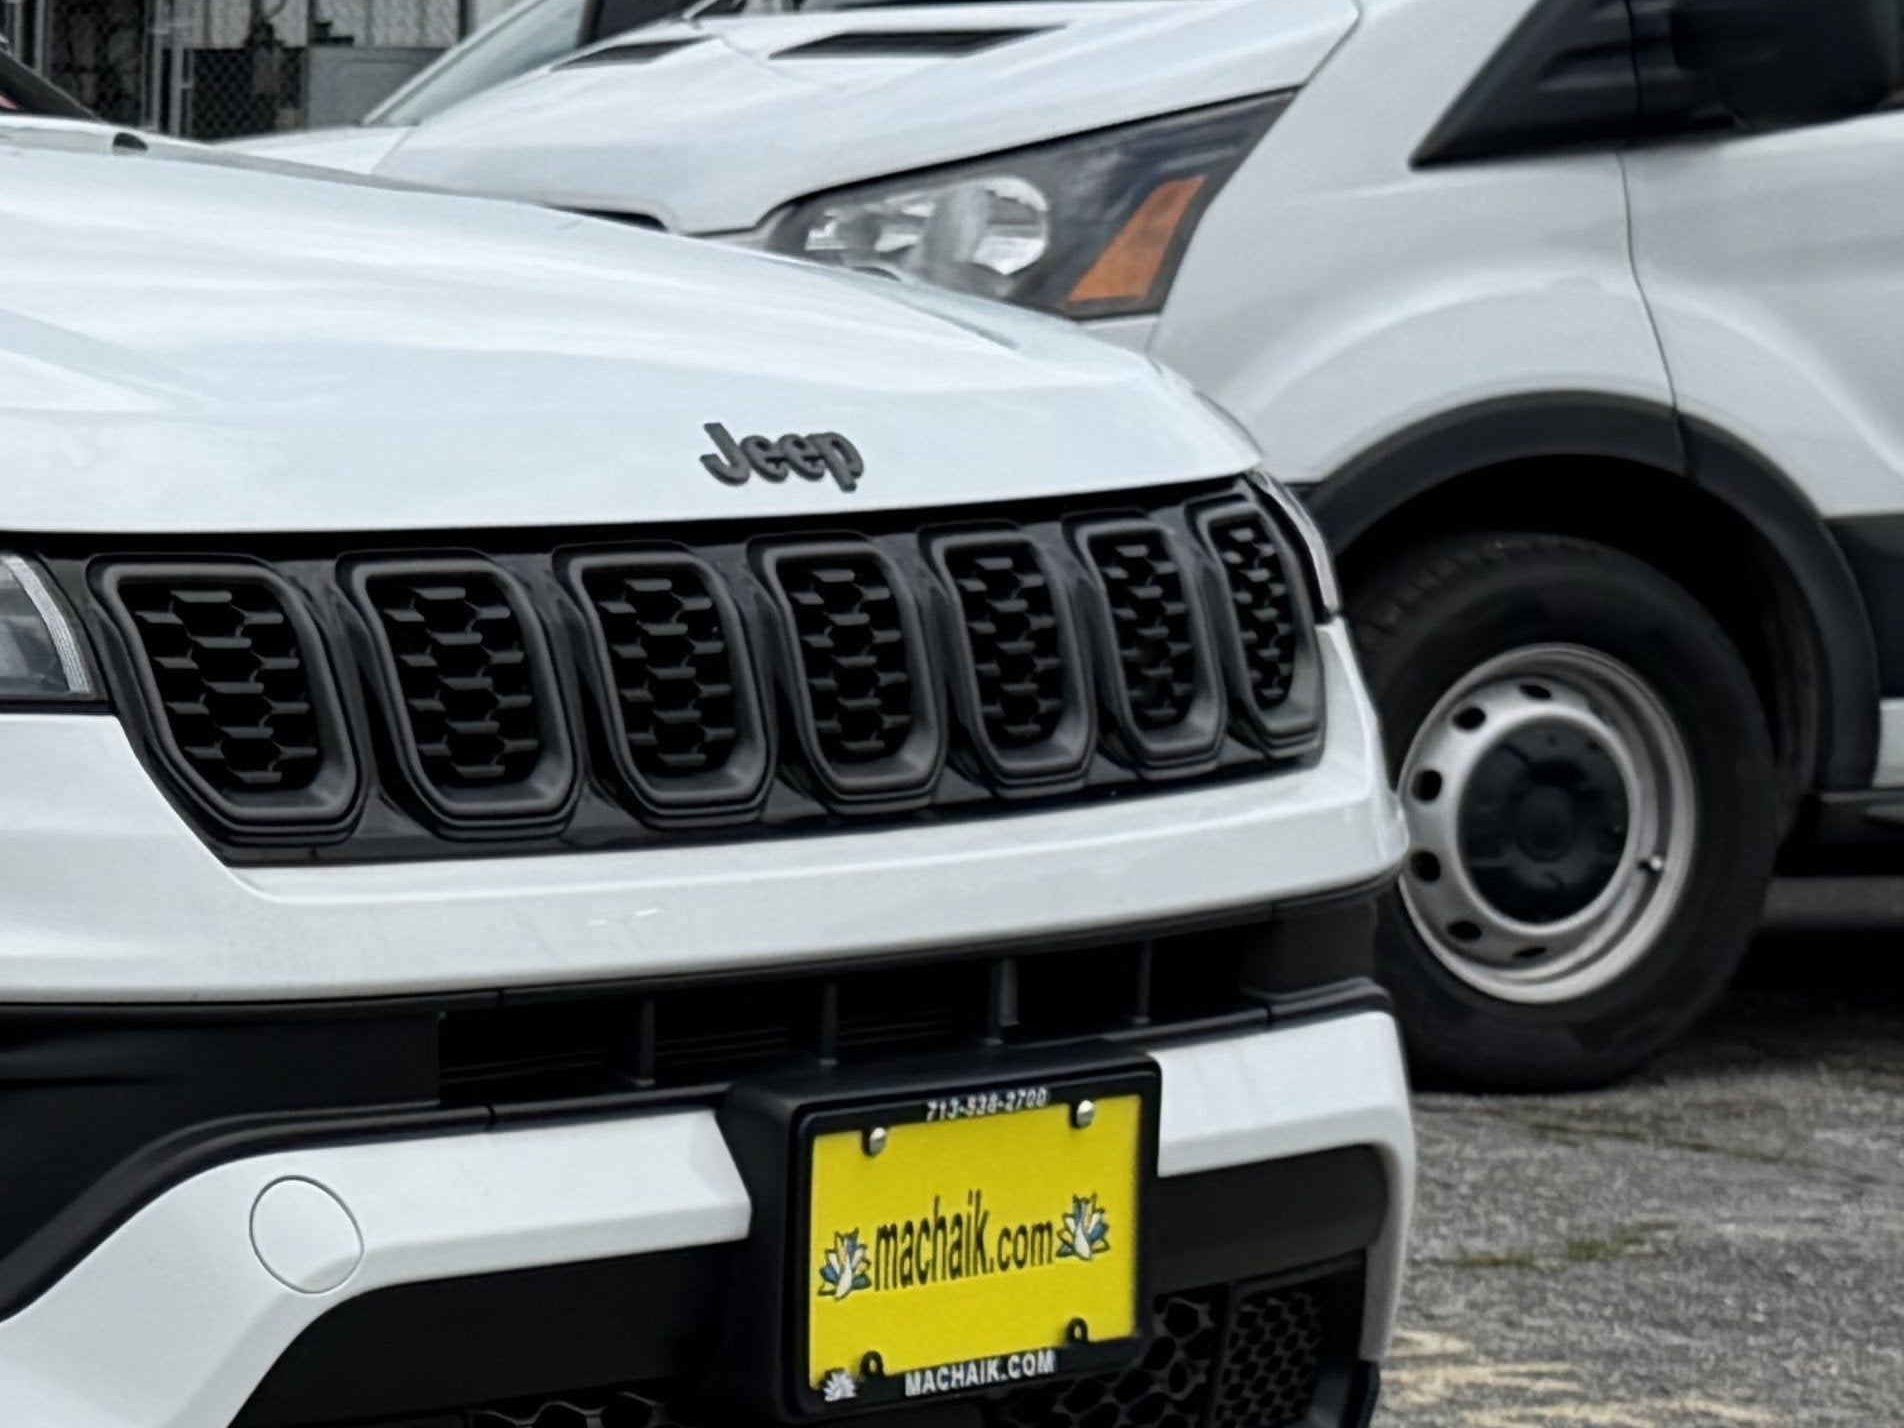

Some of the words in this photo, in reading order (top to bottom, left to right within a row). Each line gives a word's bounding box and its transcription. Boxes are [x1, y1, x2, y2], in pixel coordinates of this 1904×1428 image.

[700, 421, 865, 493] Jeep
[874, 1188, 1054, 1292] machaik.com
[904, 1348, 1056, 1398] MACHAIK.COM
